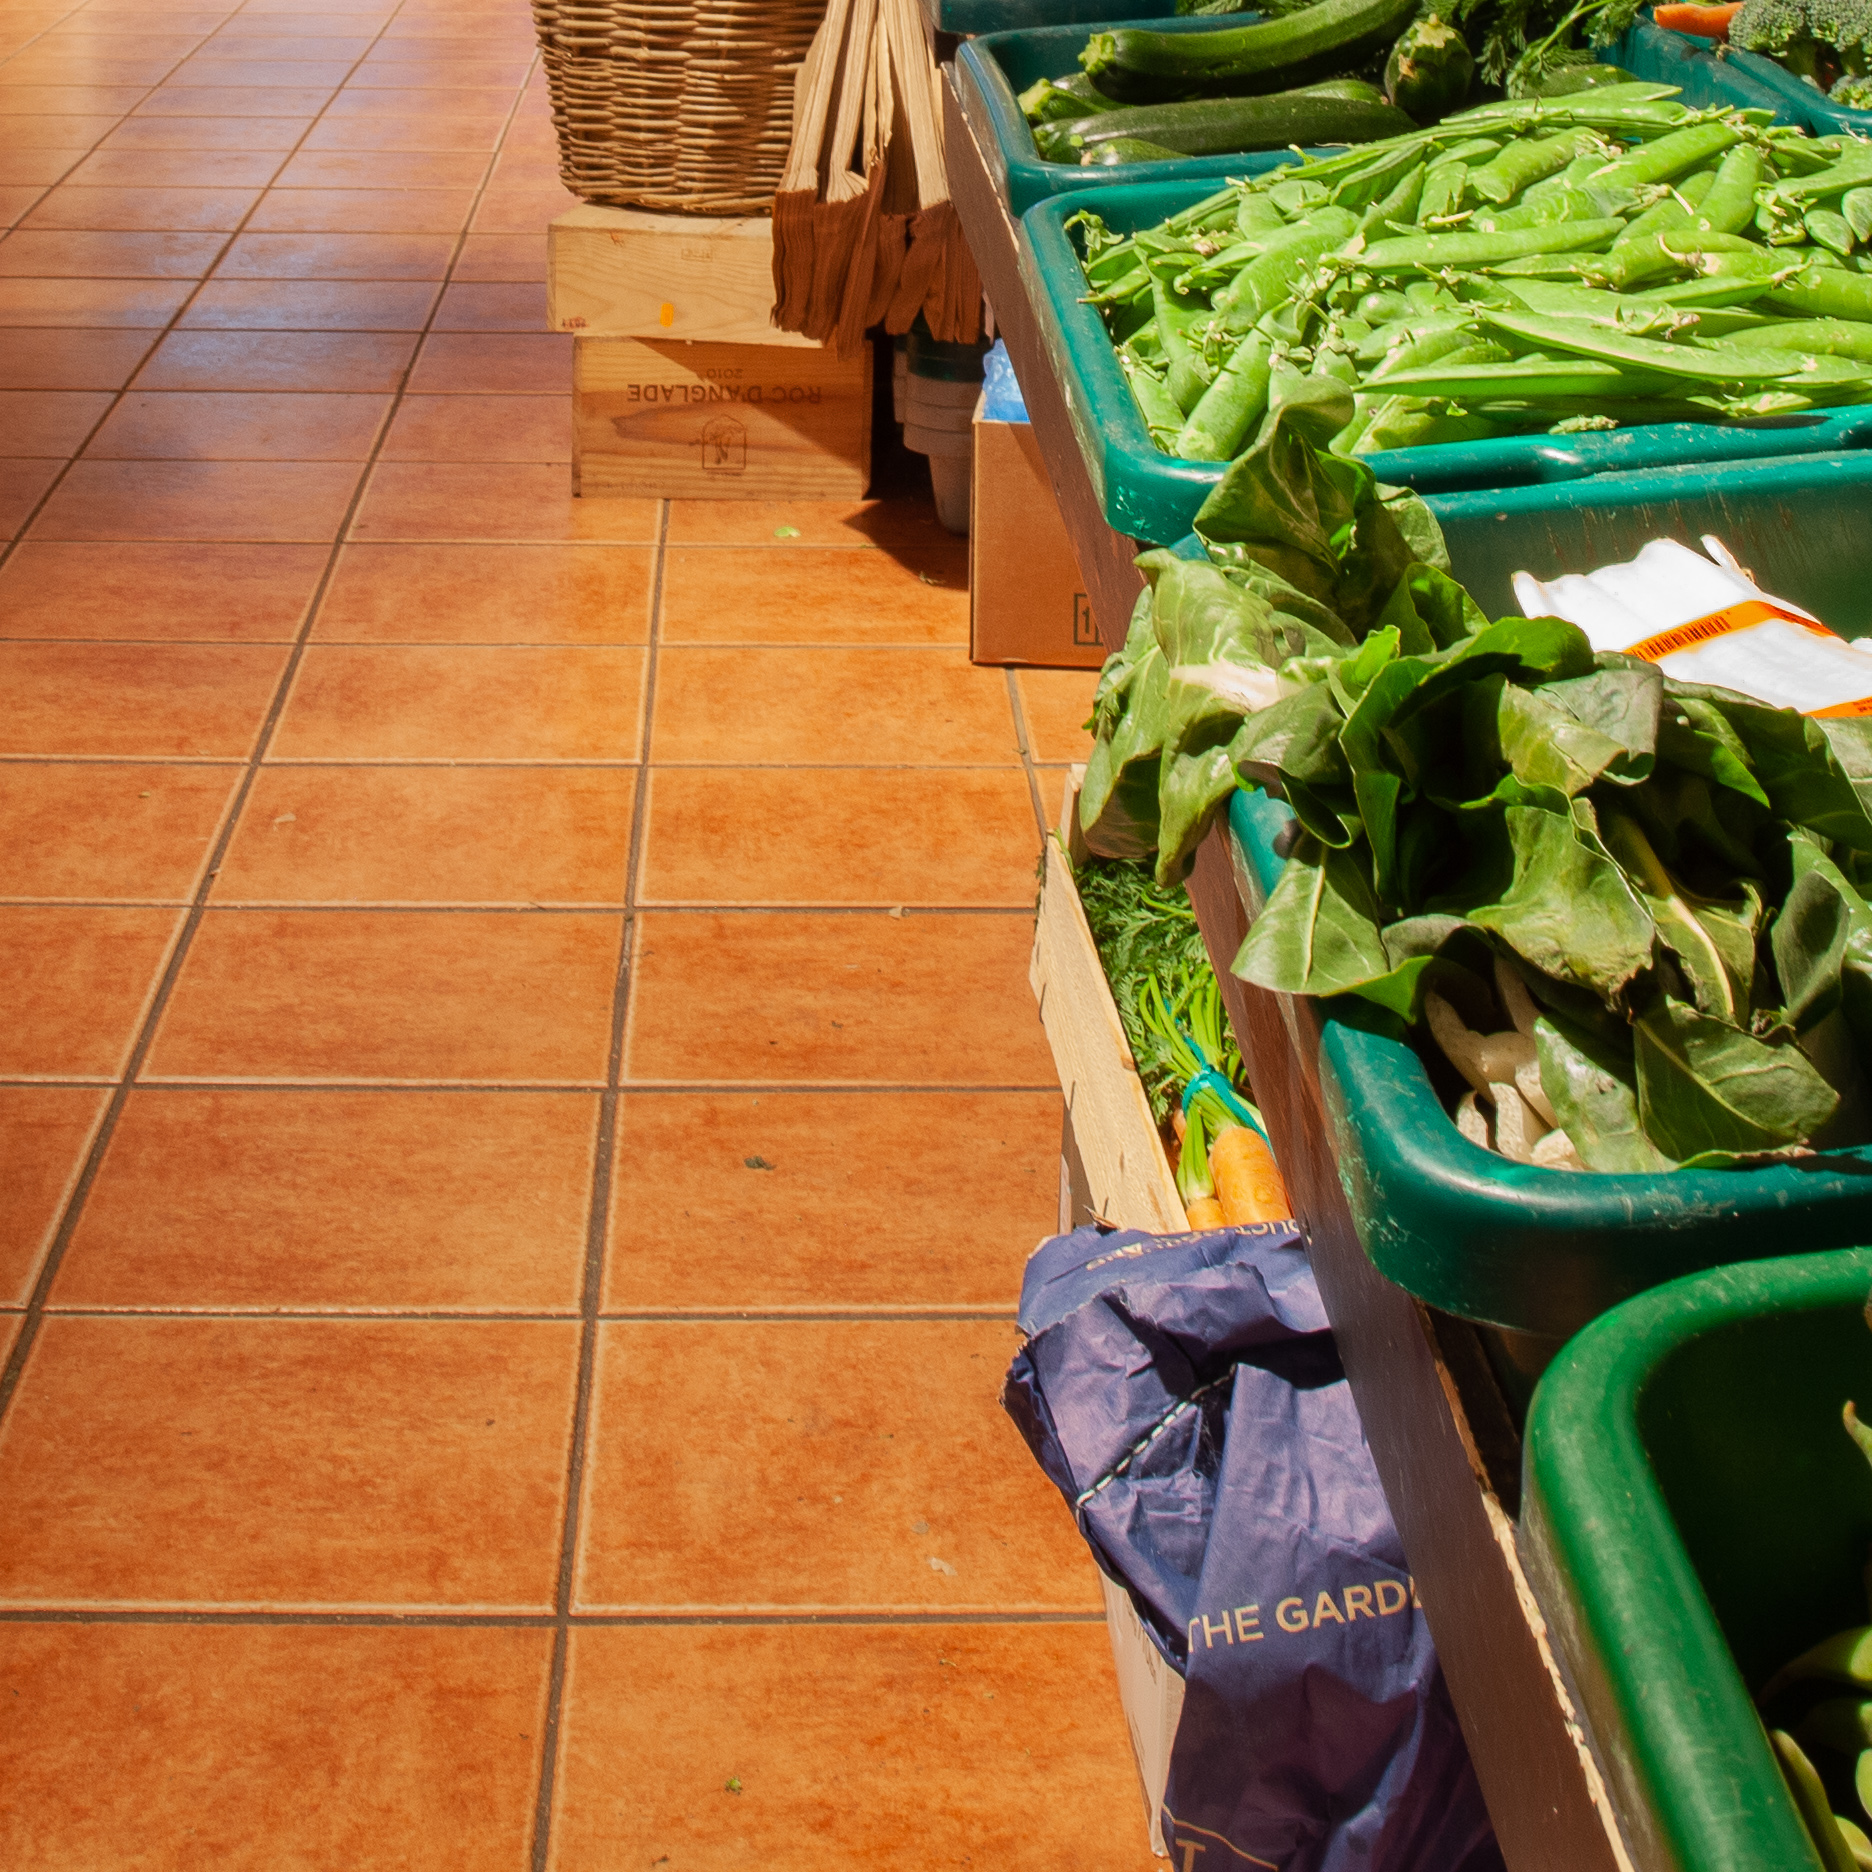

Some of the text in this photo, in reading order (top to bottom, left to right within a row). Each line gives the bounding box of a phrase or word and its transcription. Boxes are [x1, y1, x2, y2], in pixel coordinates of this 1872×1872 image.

[705, 367, 744, 379] 2010
[627, 383, 822, 405] ROC D'ANGLADE
[1188, 1603, 1264, 1653] THE
